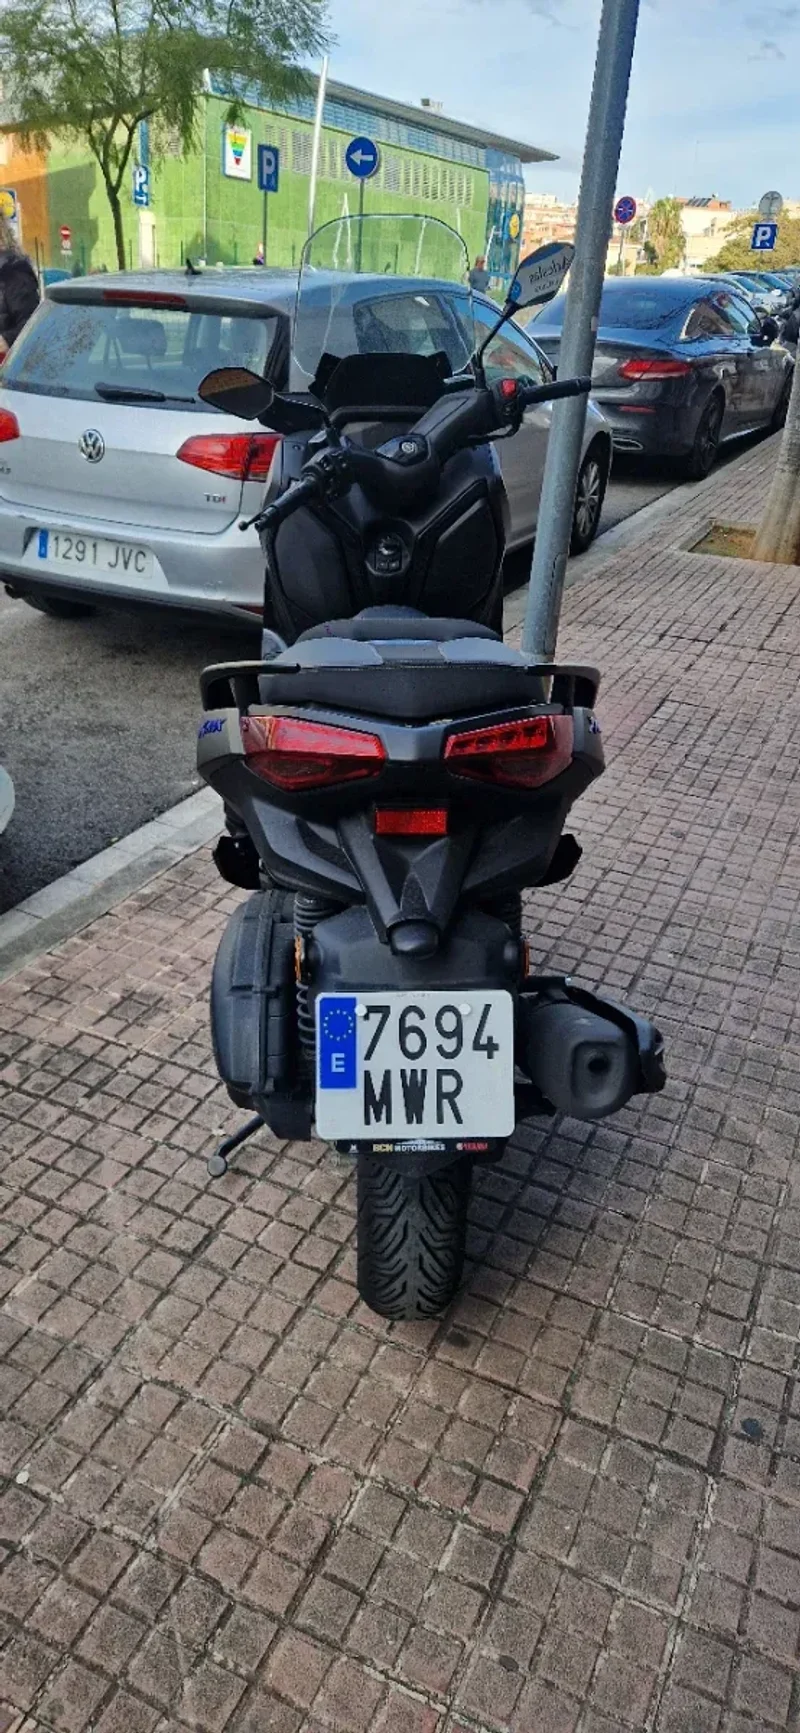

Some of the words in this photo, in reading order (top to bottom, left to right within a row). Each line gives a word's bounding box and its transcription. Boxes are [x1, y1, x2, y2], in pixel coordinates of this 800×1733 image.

[263, 149, 276, 186] P
[755, 225, 771, 247] P
[53, 535, 98, 566] 1291
[108, 546, 147, 573] JVC
[363, 1003, 499, 1061] 7694
[331, 1053, 345, 1073] E
[363, 1068, 464, 1126] MWR
